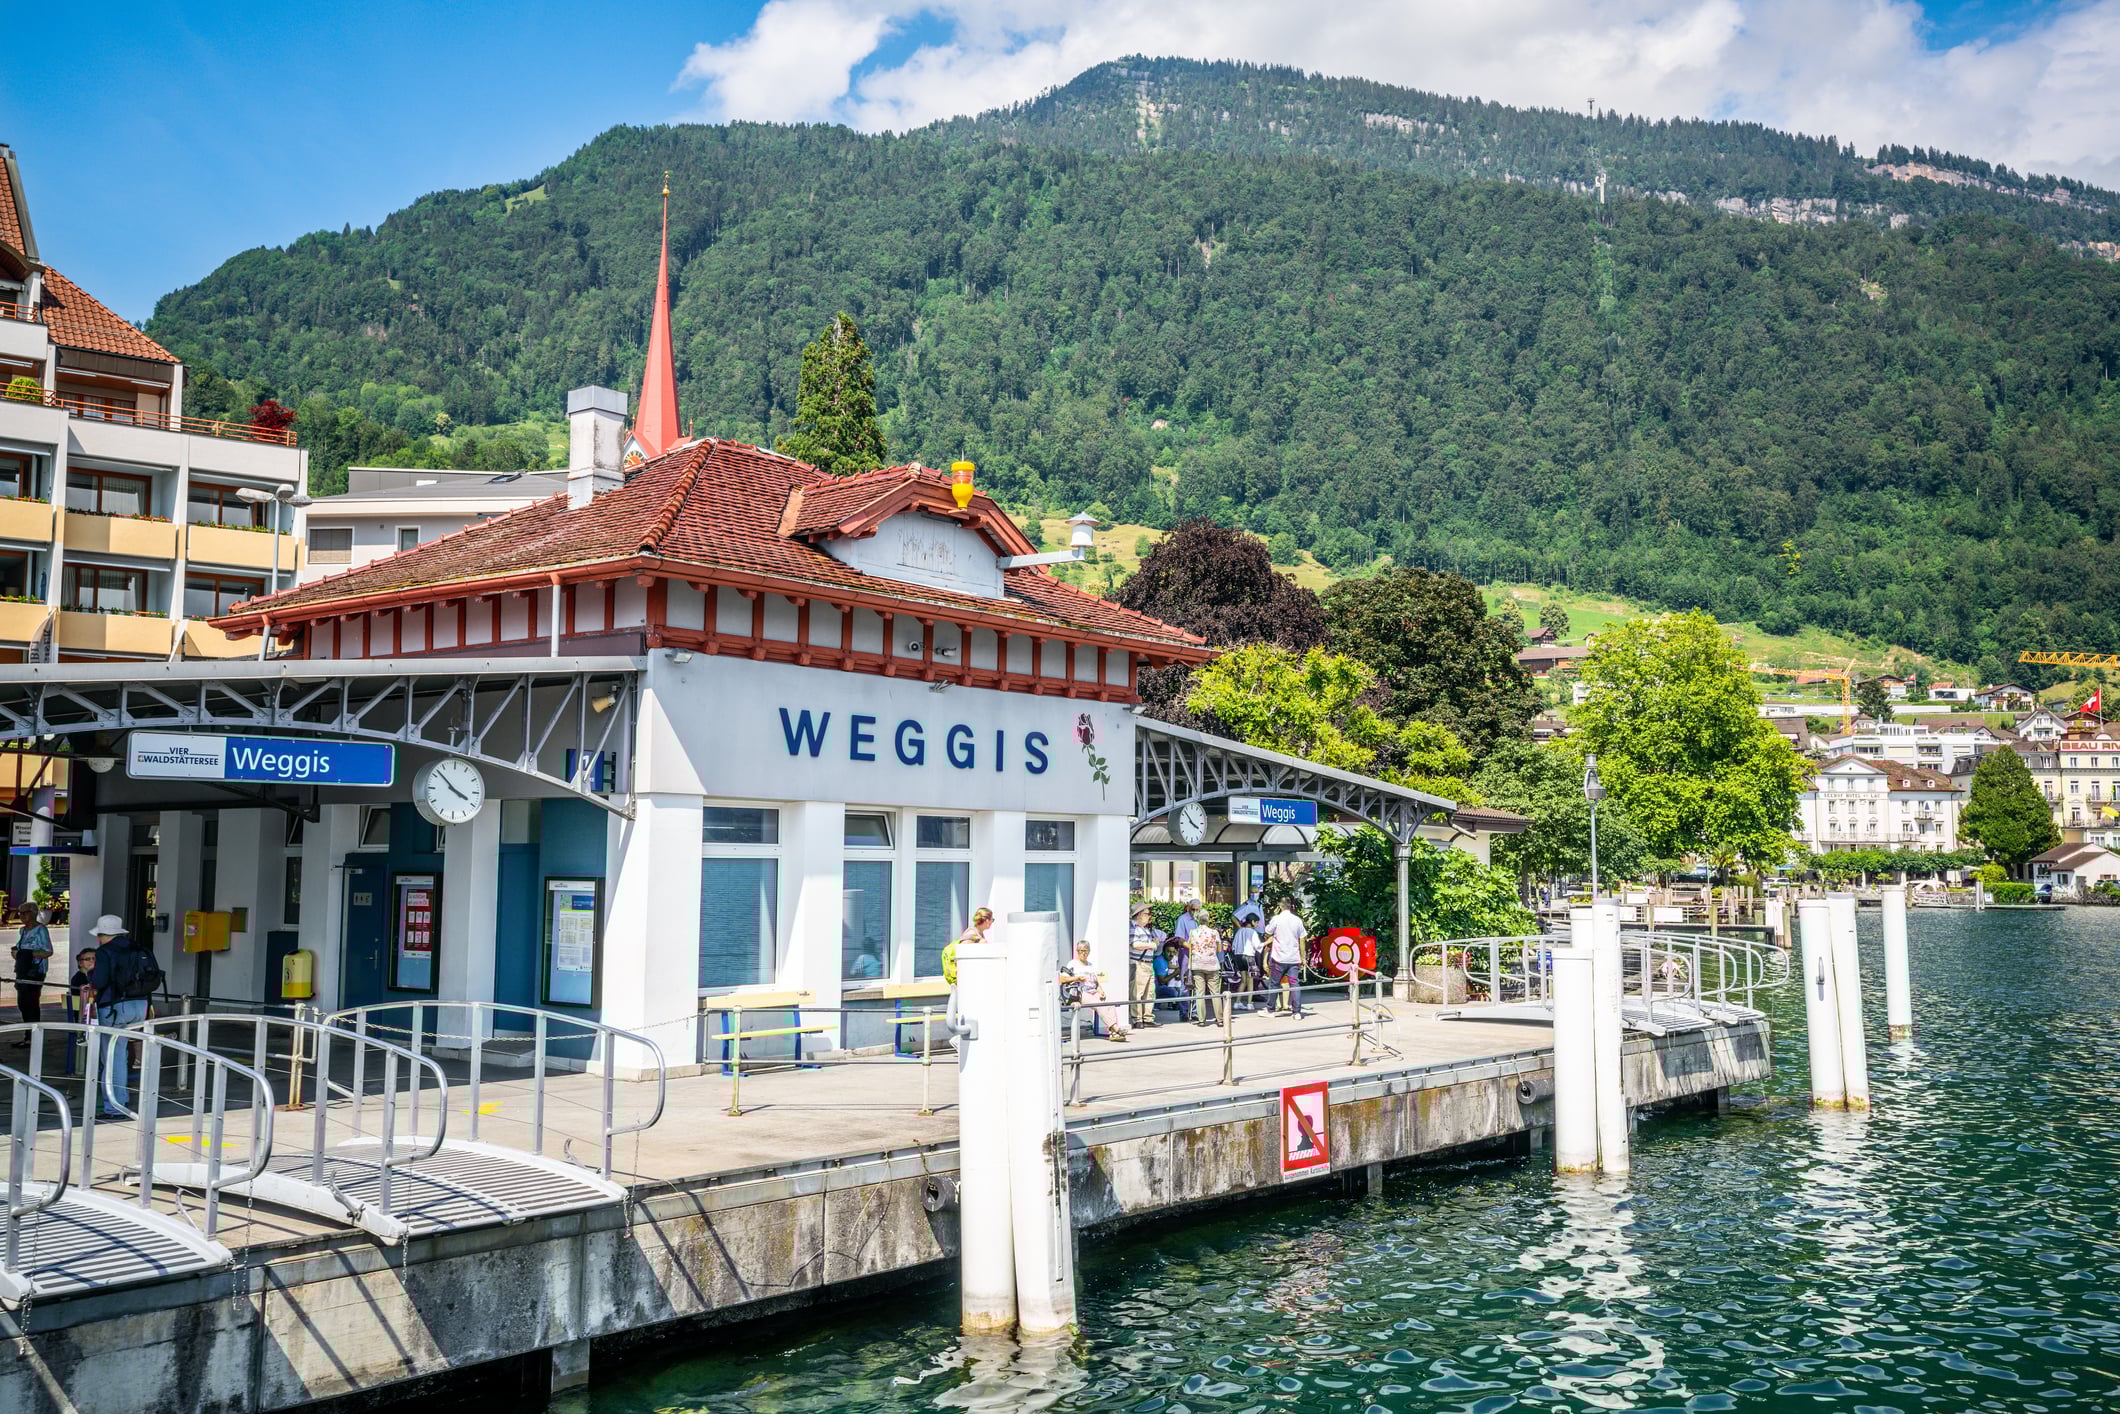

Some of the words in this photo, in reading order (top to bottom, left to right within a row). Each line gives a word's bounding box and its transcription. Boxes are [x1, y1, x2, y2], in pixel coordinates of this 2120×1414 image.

[778, 707, 1049, 774] WEGGIS
[2061, 742, 2098, 750] BEAU
[169, 747, 189, 755] VIER
[143, 755, 219, 766] WALDSTÄTTERSEE
[232, 747, 330, 778] Weggis
[1261, 804, 1296, 822] Weggis
